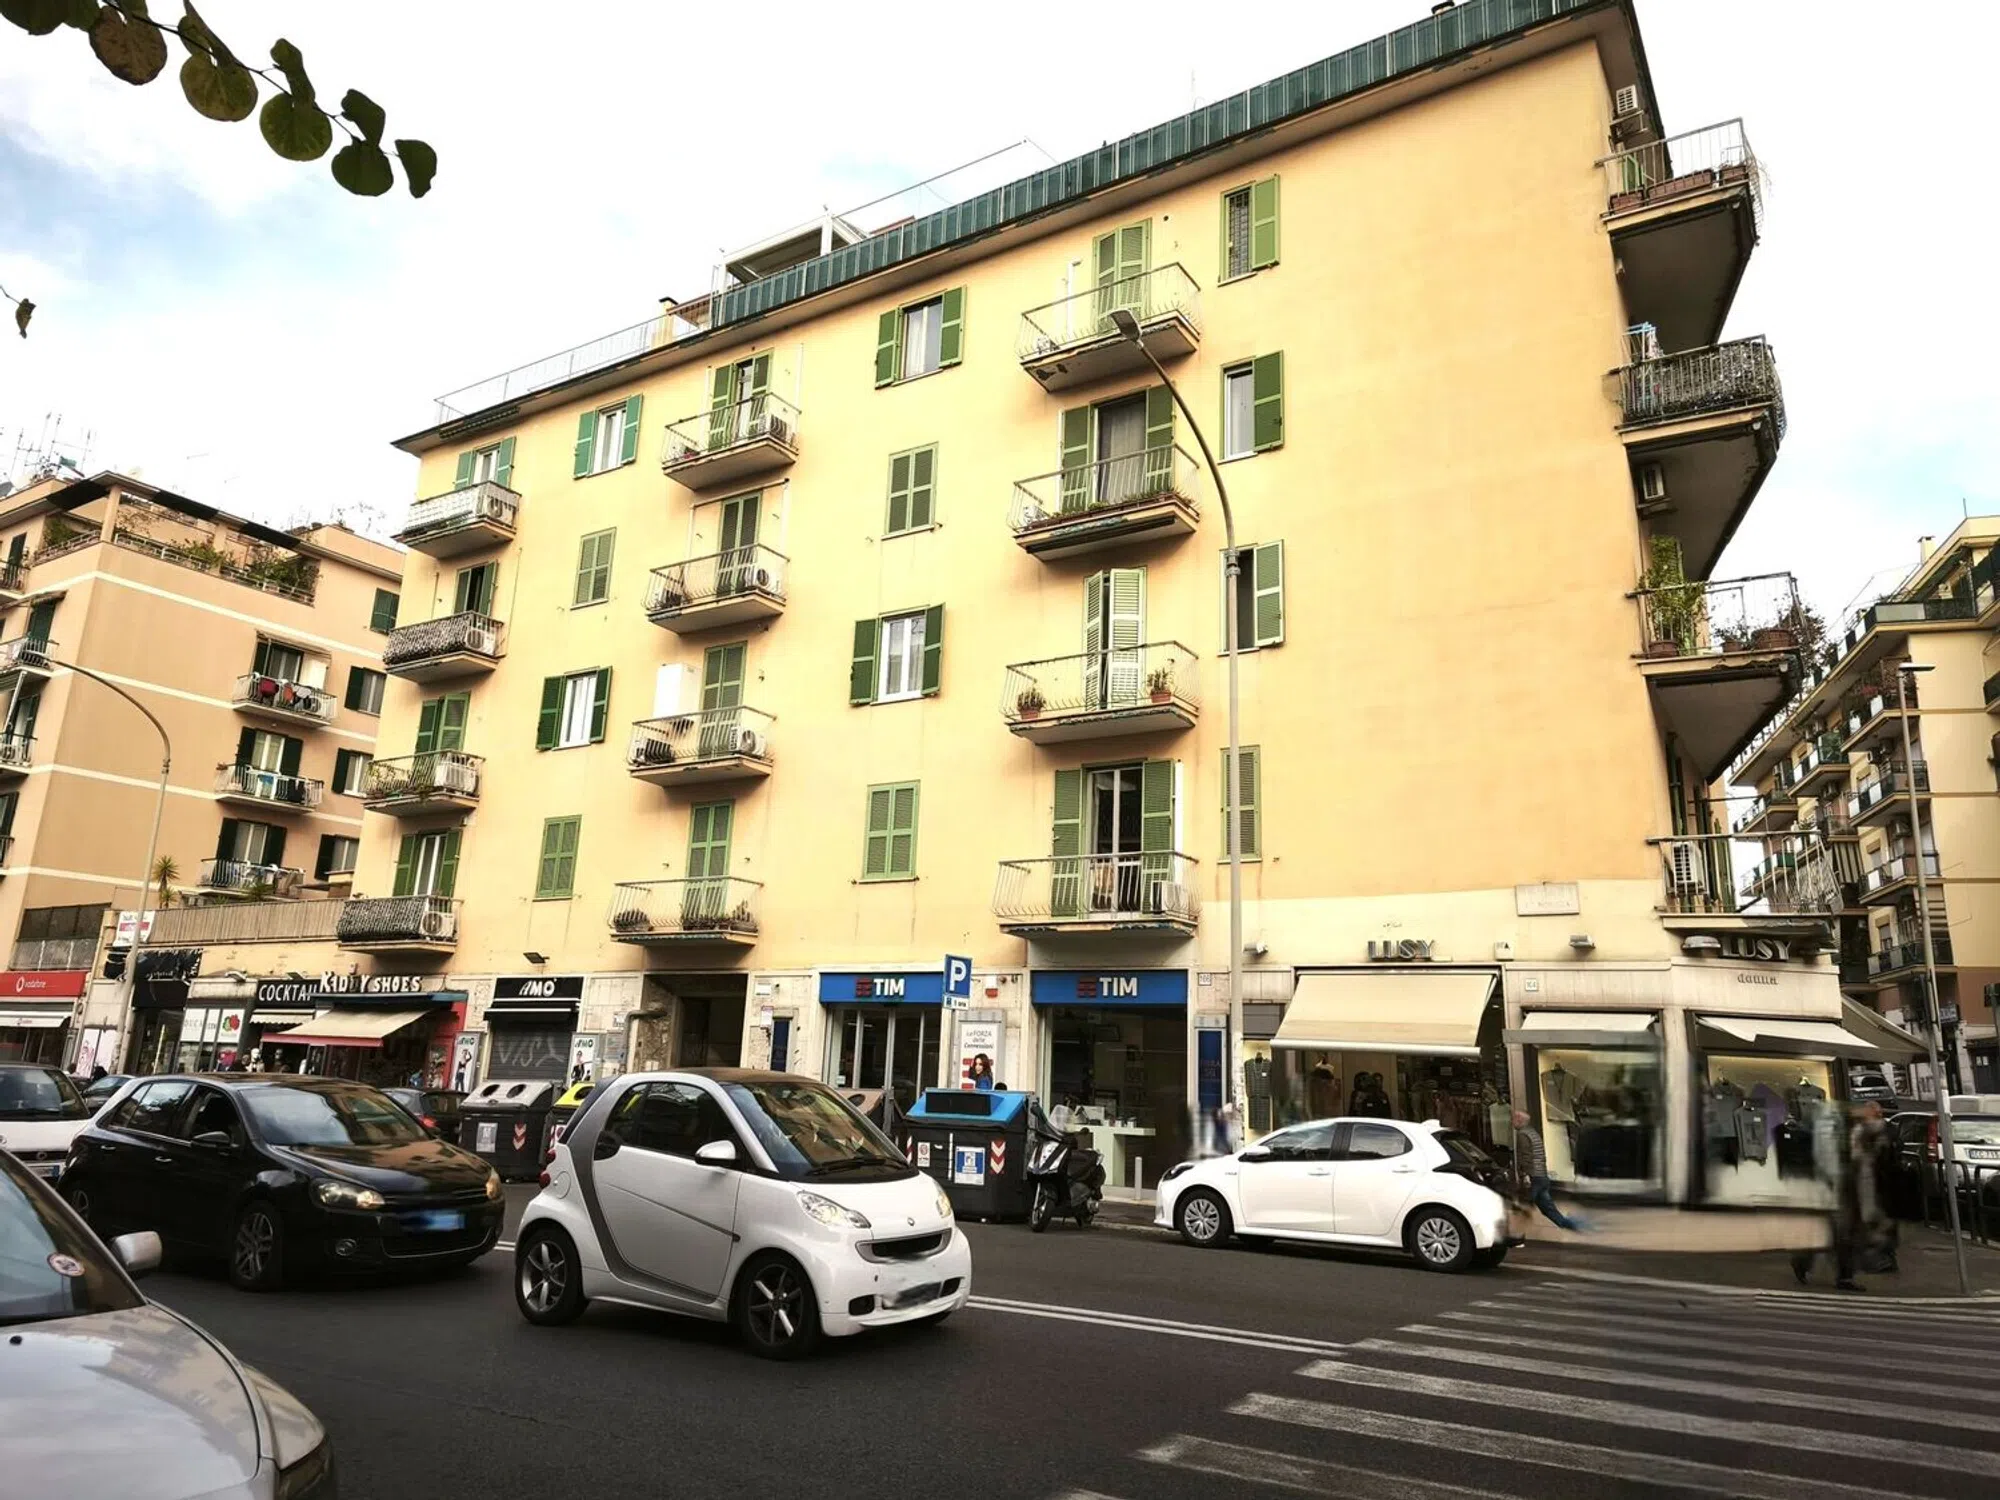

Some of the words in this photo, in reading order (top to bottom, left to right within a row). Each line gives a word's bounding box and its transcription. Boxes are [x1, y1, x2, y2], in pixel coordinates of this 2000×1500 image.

[1368, 939, 1435, 961] LUSY
[1722, 938, 1791, 960] LUSY
[373, 976, 424, 993] SHOES
[950, 959, 966, 992] P
[873, 978, 905, 997] TIM
[1099, 977, 1138, 996] TIM
